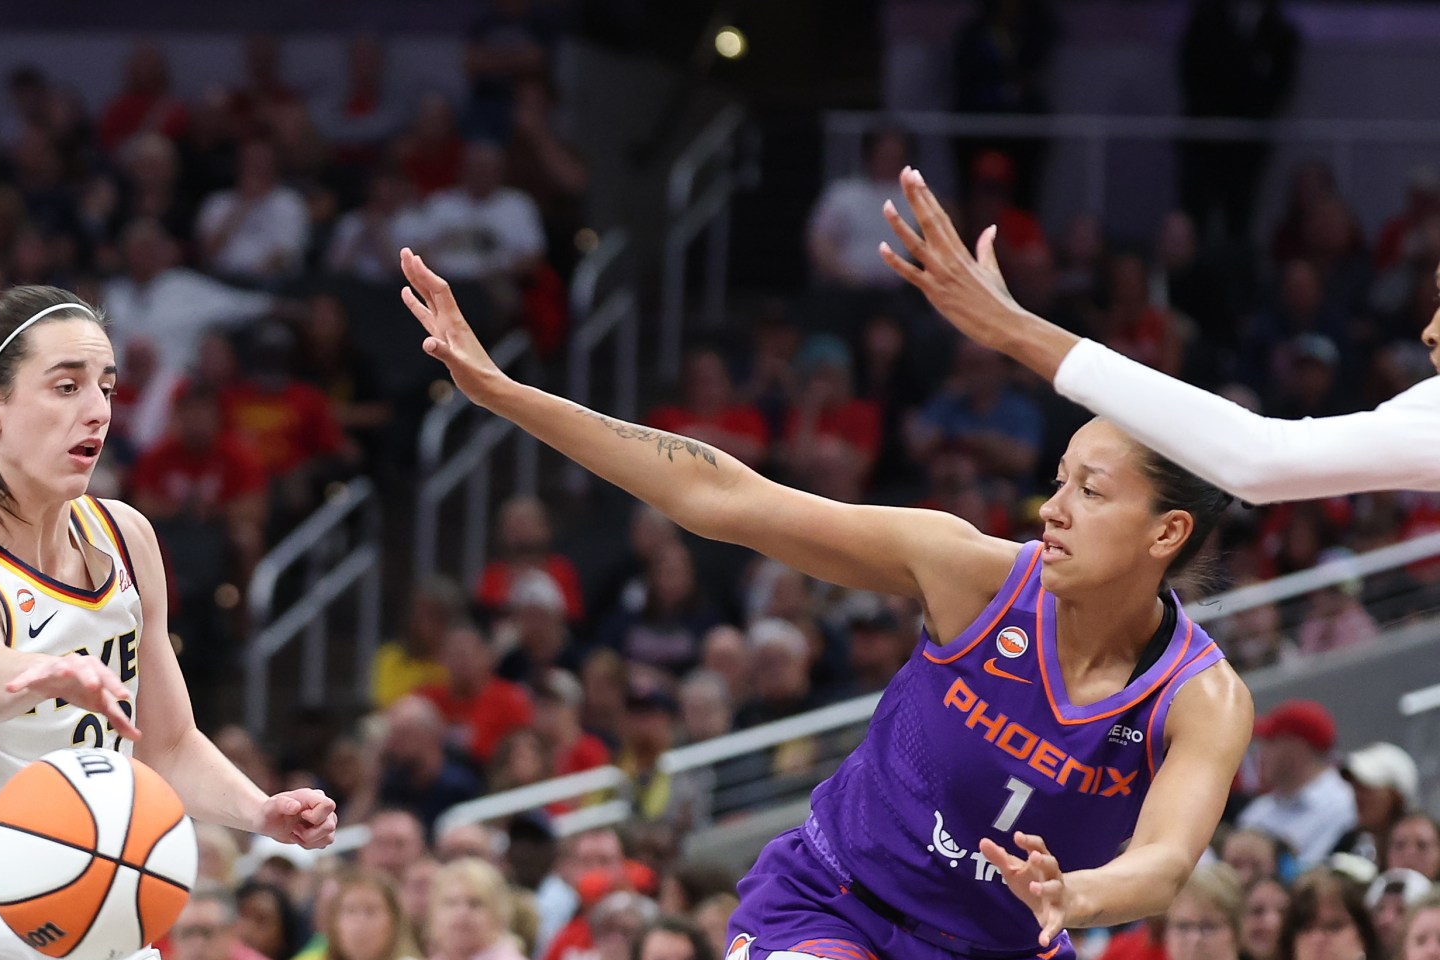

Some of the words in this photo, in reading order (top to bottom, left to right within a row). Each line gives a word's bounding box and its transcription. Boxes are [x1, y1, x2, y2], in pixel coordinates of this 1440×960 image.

[943, 677, 1138, 797] PHOENIX
[1108, 724, 1144, 743] ERO
[992, 775, 1035, 832] 1
